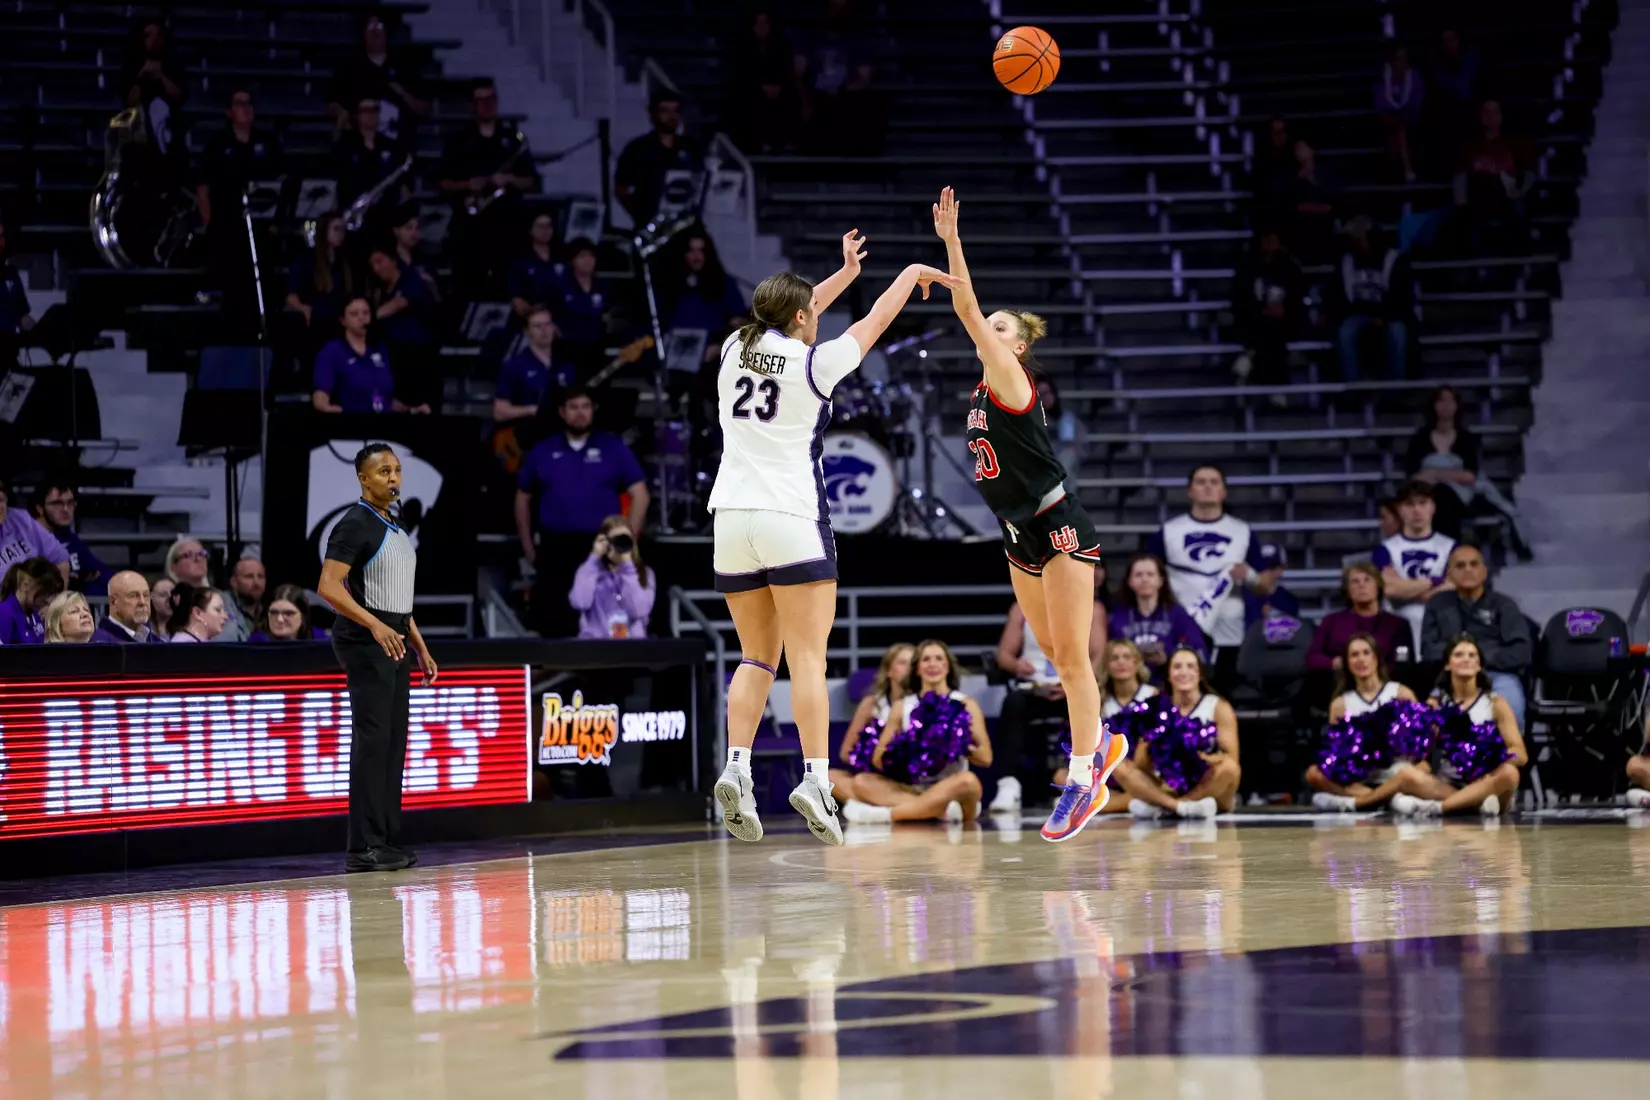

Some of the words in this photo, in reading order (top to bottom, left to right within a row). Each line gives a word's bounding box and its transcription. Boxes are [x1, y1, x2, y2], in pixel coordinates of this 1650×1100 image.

[738, 351, 786, 375] SPEISER
[732, 376, 781, 423] 23
[0, 540, 31, 567] TATE
[542, 689, 619, 765] Briggs
[621, 711, 657, 742] SINCE
[657, 710, 686, 740] 1979
[43, 693, 287, 815] RAISING
